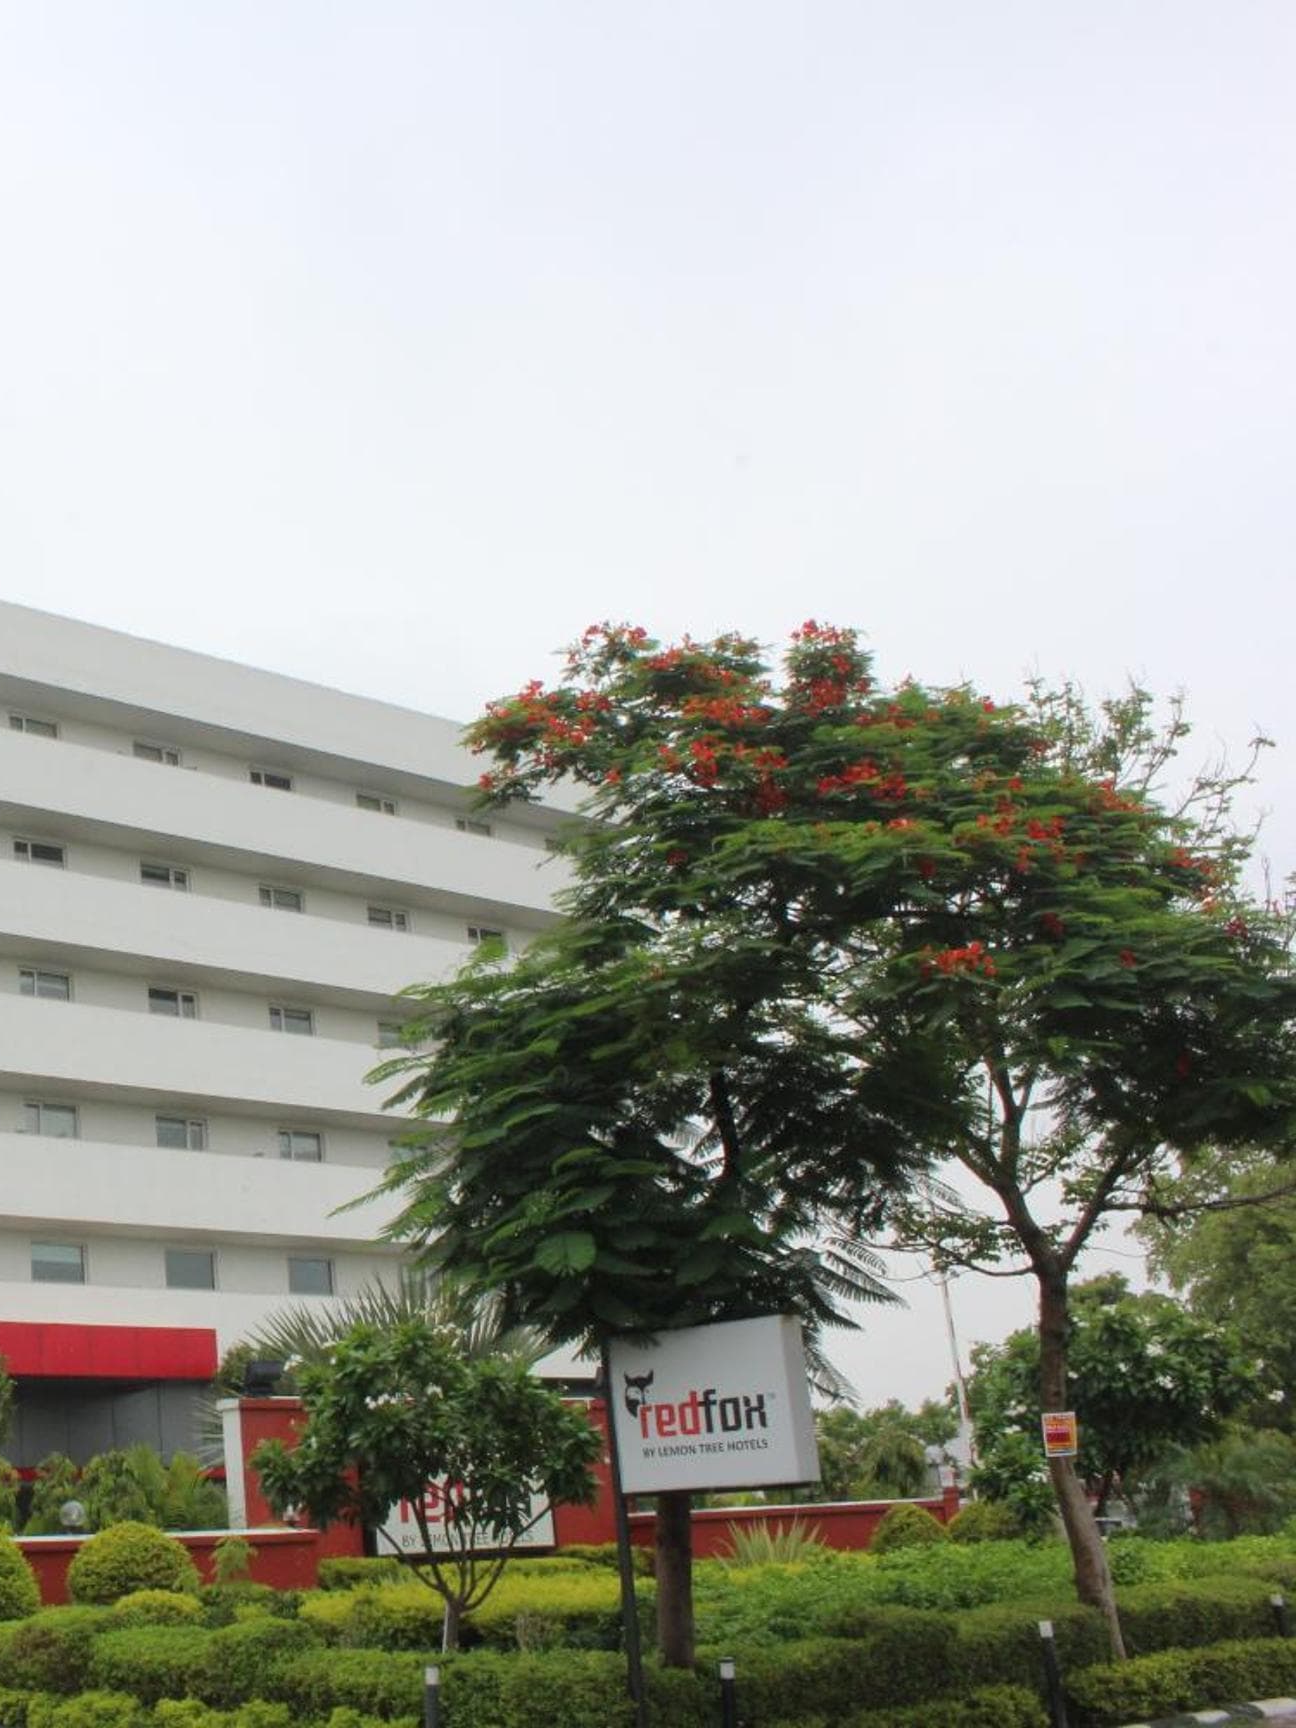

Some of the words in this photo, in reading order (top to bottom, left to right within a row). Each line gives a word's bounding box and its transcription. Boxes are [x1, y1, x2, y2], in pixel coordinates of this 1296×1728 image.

[639, 1388, 768, 1439] redfox
[642, 1447, 655, 1458] BY
[657, 1445, 696, 1457] LEMON
[698, 1442, 724, 1453] TREE
[727, 1438, 768, 1450] HOTELS
